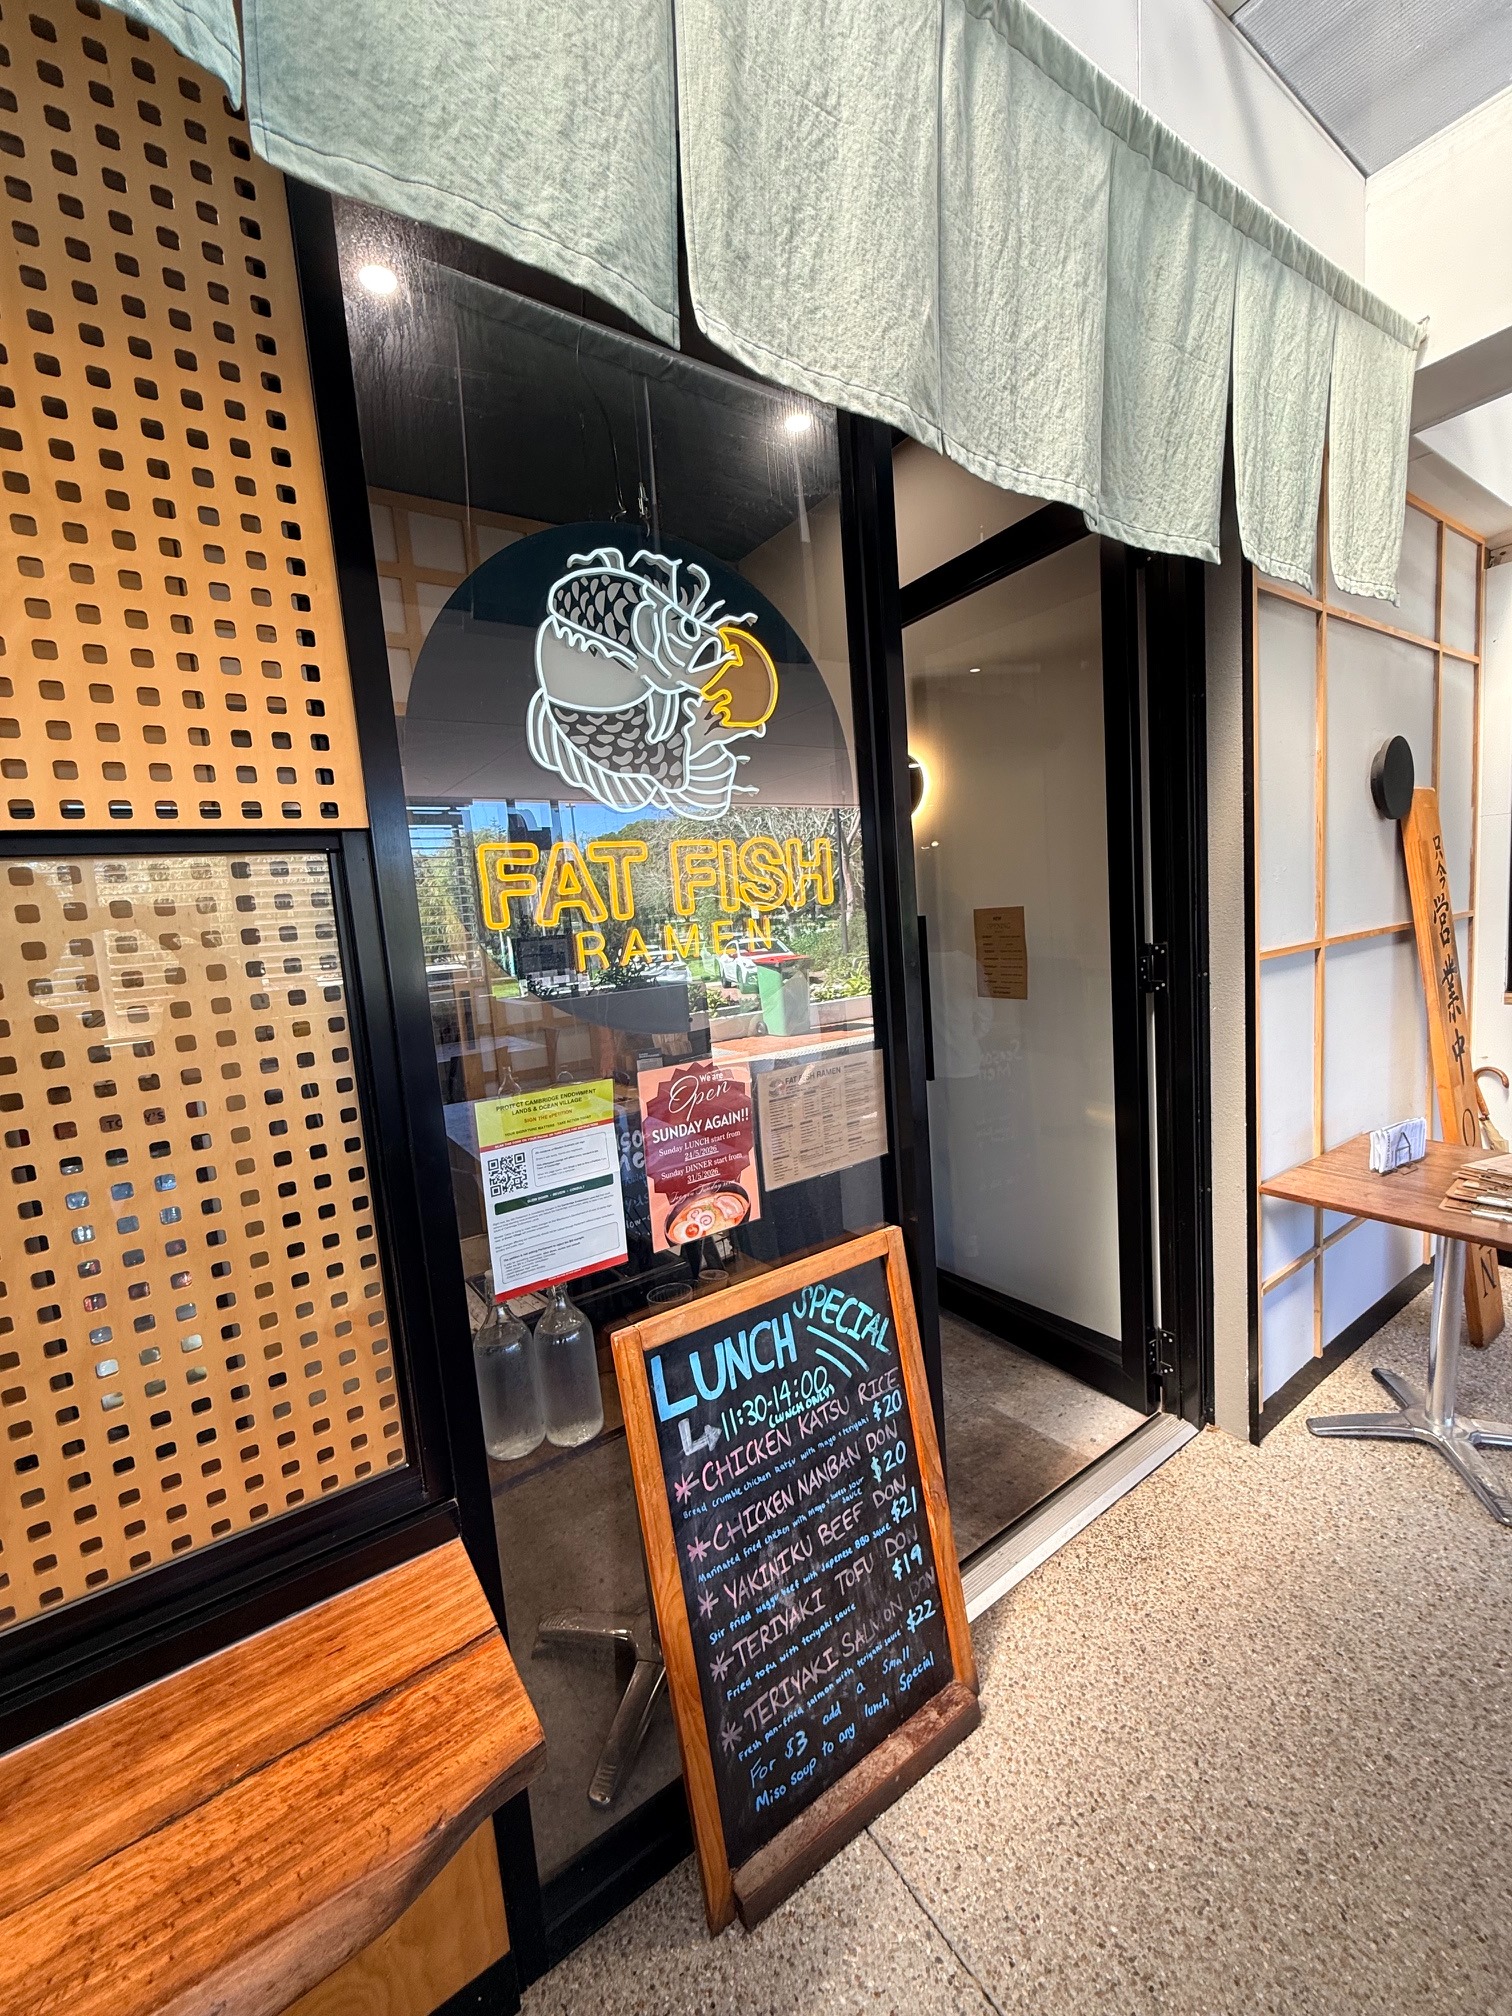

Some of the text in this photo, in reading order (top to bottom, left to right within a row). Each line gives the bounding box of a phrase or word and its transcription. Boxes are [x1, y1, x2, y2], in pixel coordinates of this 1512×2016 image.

[477, 837, 834, 930] FAT FISH
[573, 918, 772, 973] RAMEN
[511, 1106, 532, 1116] LANDS
[538, 1102, 559, 1111] OCEAN
[558, 1097, 583, 1107] VILLAGE
[524, 1095, 559, 1108] CAMBRIDGE
[560, 1089, 597, 1100] ENDOWMENT
[668, 1074, 732, 1122] Open
[699, 1073, 724, 1083] We are
[785, 1066, 841, 1085] FAT FSH RAMEN
[523, 1116, 537, 1124] SIGN
[537, 1114, 548, 1122] THE
[652, 1118, 702, 1144] SUNDAY
[705, 1107, 749, 1131] AGAIN!!
[658, 1130, 741, 1158] Sunday LUNCH start from
[661, 1169, 685, 1181] Sunday
[685, 1159, 713, 1174] DINNER
[713, 1156, 728, 1166] start
[728, 1152, 743, 1162] from
[650, 1284, 892, 1423] LUNCH SPECIAL
[701, 1367, 903, 1492] CHICKEN KATSU RICE $20
[682, 1502, 708, 1520] Bread
[711, 1483, 743, 1508] crumble
[743, 1471, 772, 1491] chicken
[799, 1446, 816, 1461] with
[712, 1419, 906, 1551] CHICKEN NANBAN DON $20
[696, 1553, 742, 1585] Marinated
[764, 1524, 791, 1546] chicken
[791, 1514, 808, 1528] with
[723, 1474, 918, 1609] YAKINIKU BEEF DON $21
[708, 1627, 726, 1646] Stir
[729, 1611, 752, 1632] fried
[802, 1570, 818, 1585] with
[872, 1522, 892, 1539] sauce
[731, 1523, 923, 1668] TERIYAKI TOFU DON $19
[726, 1602, 857, 1702] Fried tofu with teriyaki sauce
[743, 1645, 840, 1732] TERIYAKI
[841, 1593, 904, 1658] SALMON
[906, 1599, 937, 1634] $22
[806, 1682, 835, 1708] salmon
[835, 1667, 855, 1685] with
[883, 1628, 902, 1647] sauce
[750, 1757, 777, 1789] For
[784, 1730, 809, 1759] $3
[822, 1700, 842, 1726] add
[856, 1682, 867, 1695] a
[754, 1784, 787, 1812] Miso
[821, 1740, 835, 1757] to
[838, 1722, 856, 1744] any
[864, 1692, 890, 1719] lunch
